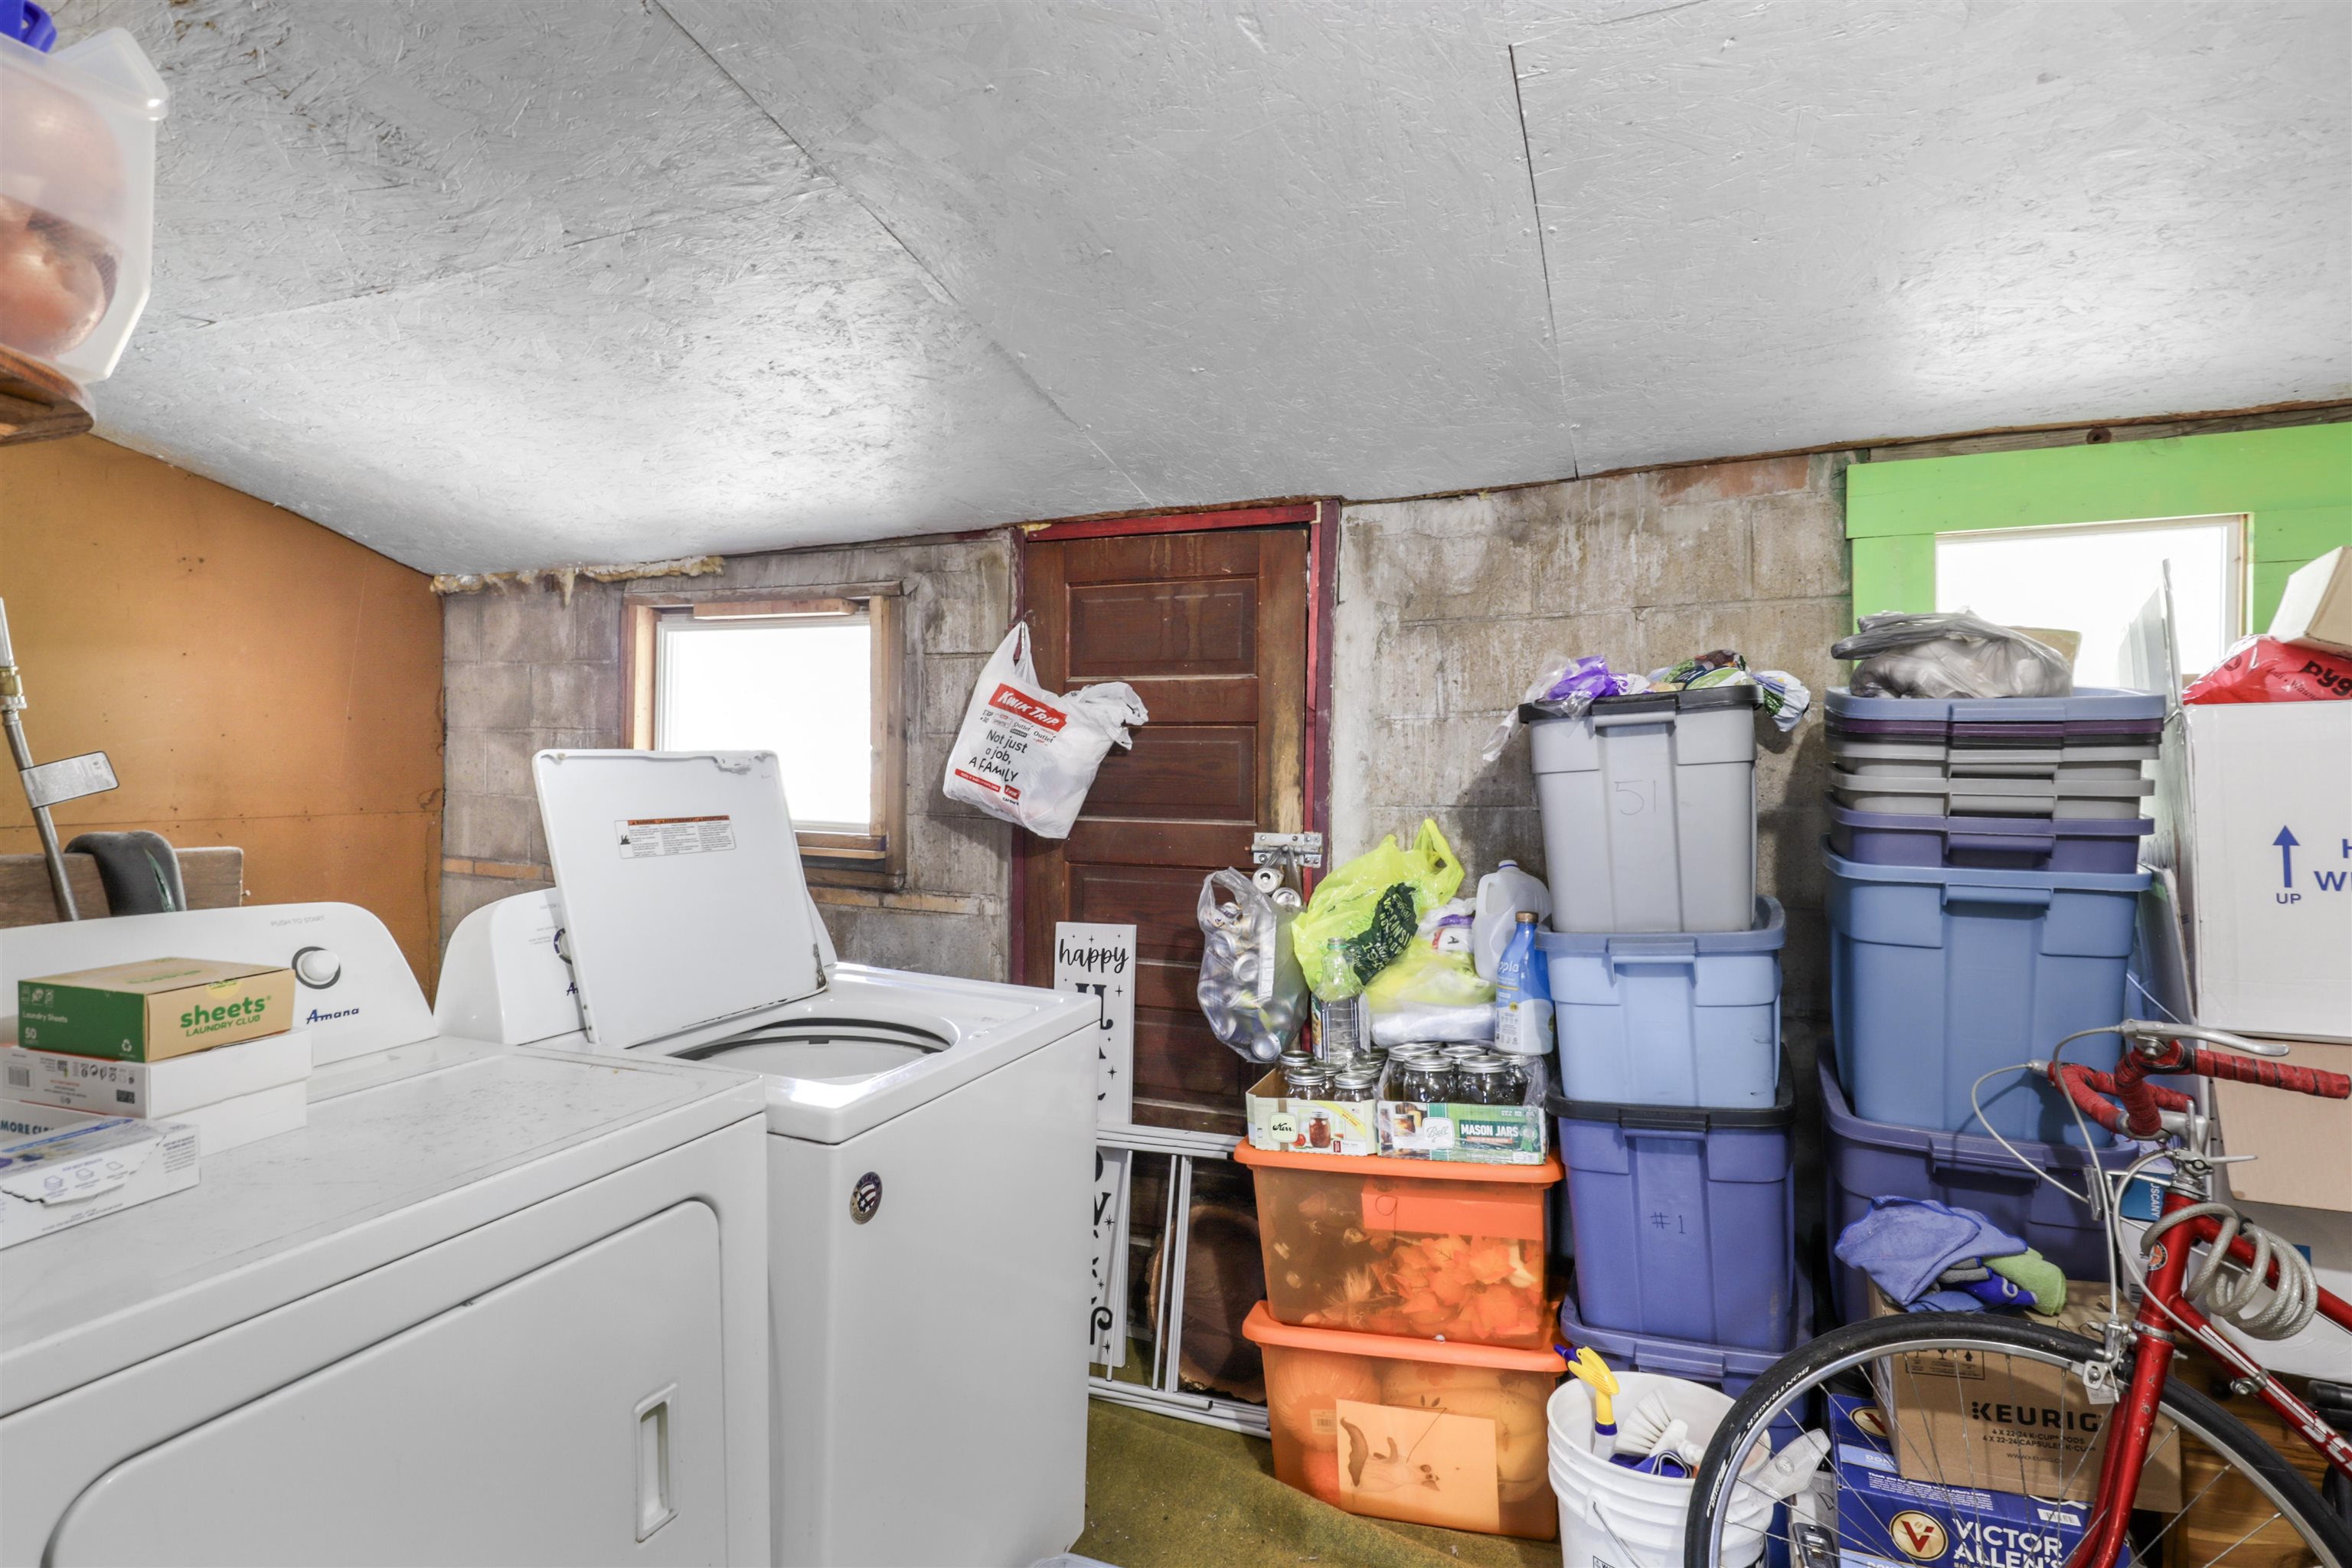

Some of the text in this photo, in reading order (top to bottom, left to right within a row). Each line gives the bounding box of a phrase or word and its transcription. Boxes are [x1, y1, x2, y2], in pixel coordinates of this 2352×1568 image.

[1028, 706, 1060, 726] TRIP
[986, 730, 1027, 753] Not just
[991, 746, 1011, 765] job,
[969, 756, 978, 767] A
[978, 758, 1018, 782] FAMILY
[1614, 779, 1657, 815] 51
[2276, 893, 2301, 904] UP
[304, 915, 325, 923] START
[1059, 938, 1129, 974] happy
[180, 996, 266, 1028] sheets
[306, 1008, 360, 1024] Amana
[24, 1027, 38, 1039] 50
[186, 1014, 261, 1037] LAUNDRY CLUB
[0, 1119, 30, 1135] MORE
[1272, 1122, 1292, 1132] Kerr
[1461, 1123, 1519, 1137] MASON JARS
[1746, 1366, 1810, 1429] BONTRAGER
[1971, 1401, 2099, 1432] KEURIG
[1952, 1518, 2063, 1558] VICTOR
